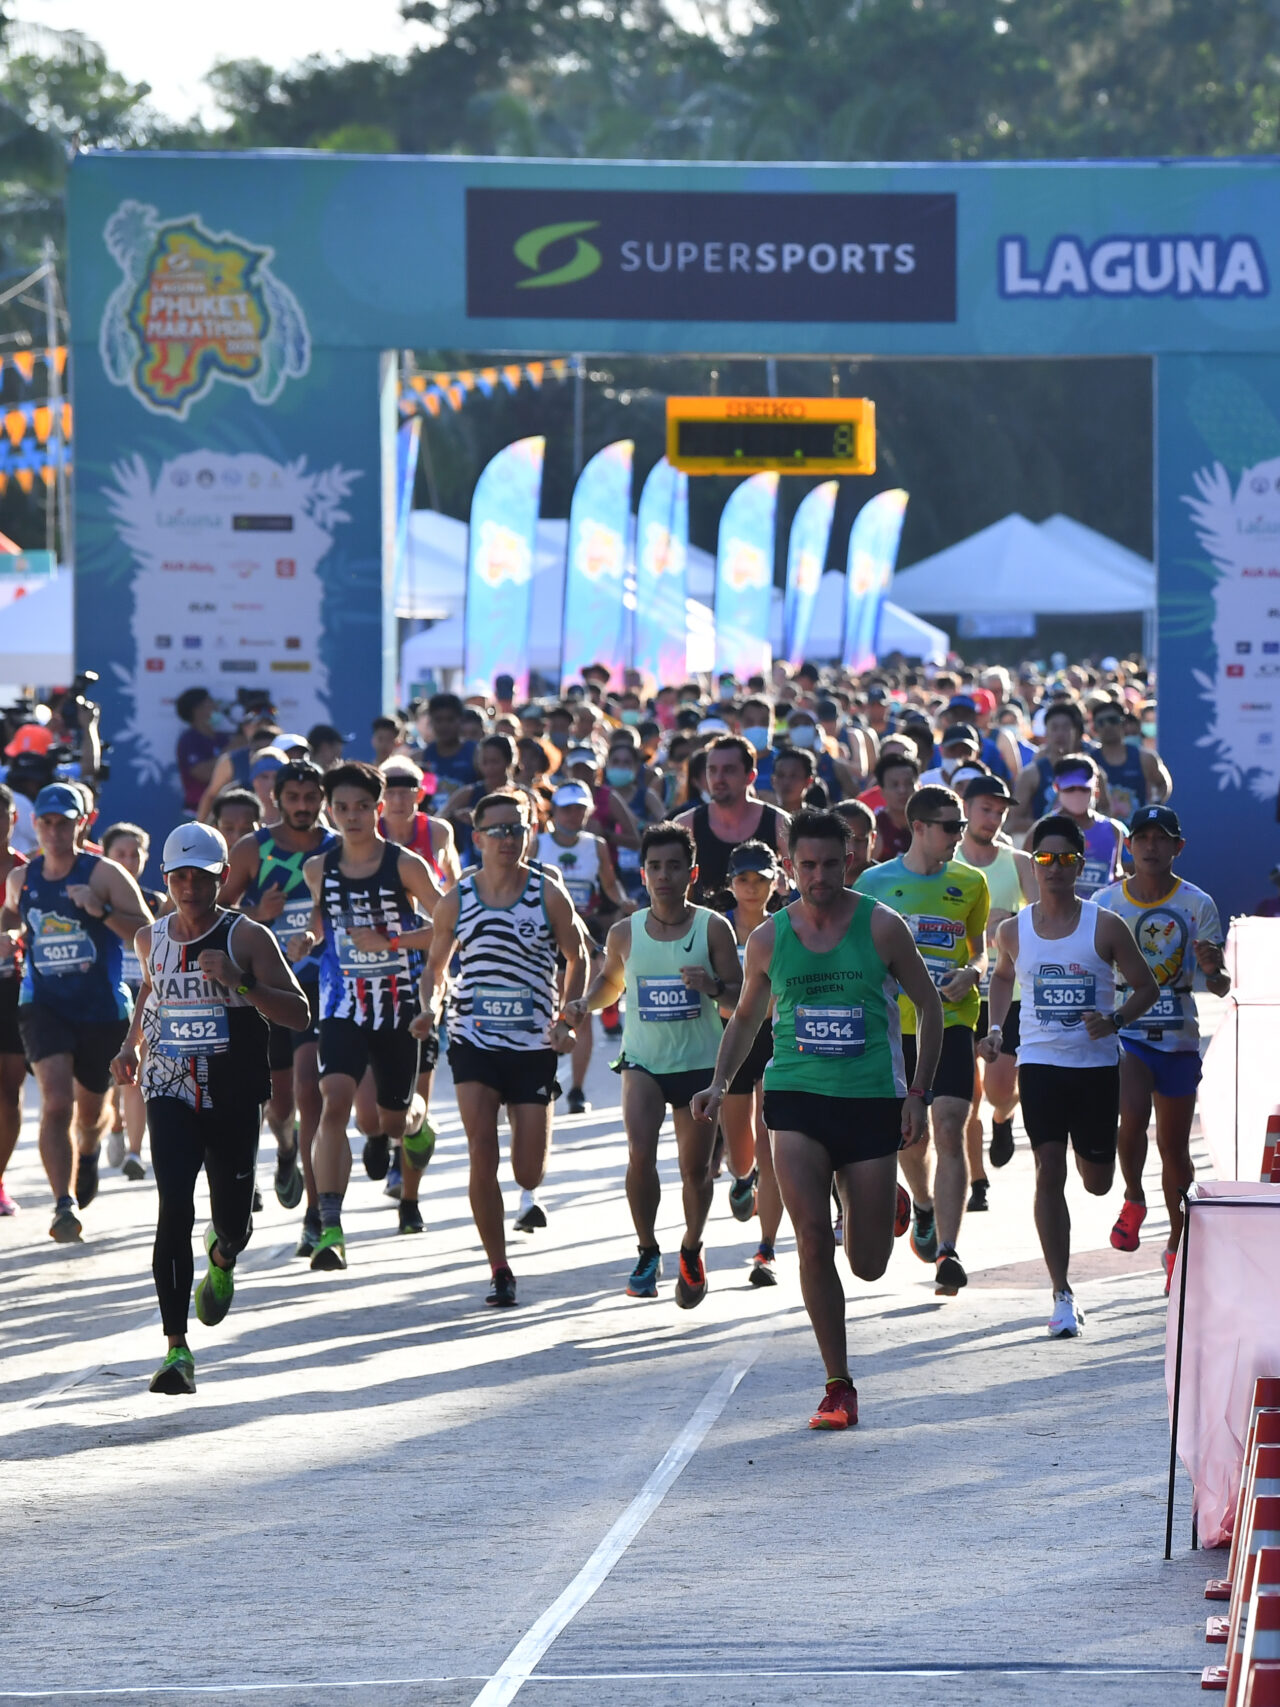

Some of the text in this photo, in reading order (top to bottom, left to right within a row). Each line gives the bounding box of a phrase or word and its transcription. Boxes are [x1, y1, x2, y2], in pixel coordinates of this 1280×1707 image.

[620, 241, 916, 273] SUPERSPORTS
[1003, 239, 1264, 294] LAGUNA
[151, 294, 248, 317] PHUKET
[146, 320, 255, 337] MARATHON
[725, 401, 806, 418] SEIKO
[43, 944, 78, 960] 9017
[785, 971, 863, 987] STUBBINGTON
[649, 990, 688, 1005] 9001
[806, 984, 845, 996] GREEN
[1042, 989, 1086, 1004] 9303
[482, 1001, 524, 1015] 9678
[170, 1021, 218, 1038] 9452
[805, 1021, 854, 1038] 9594
